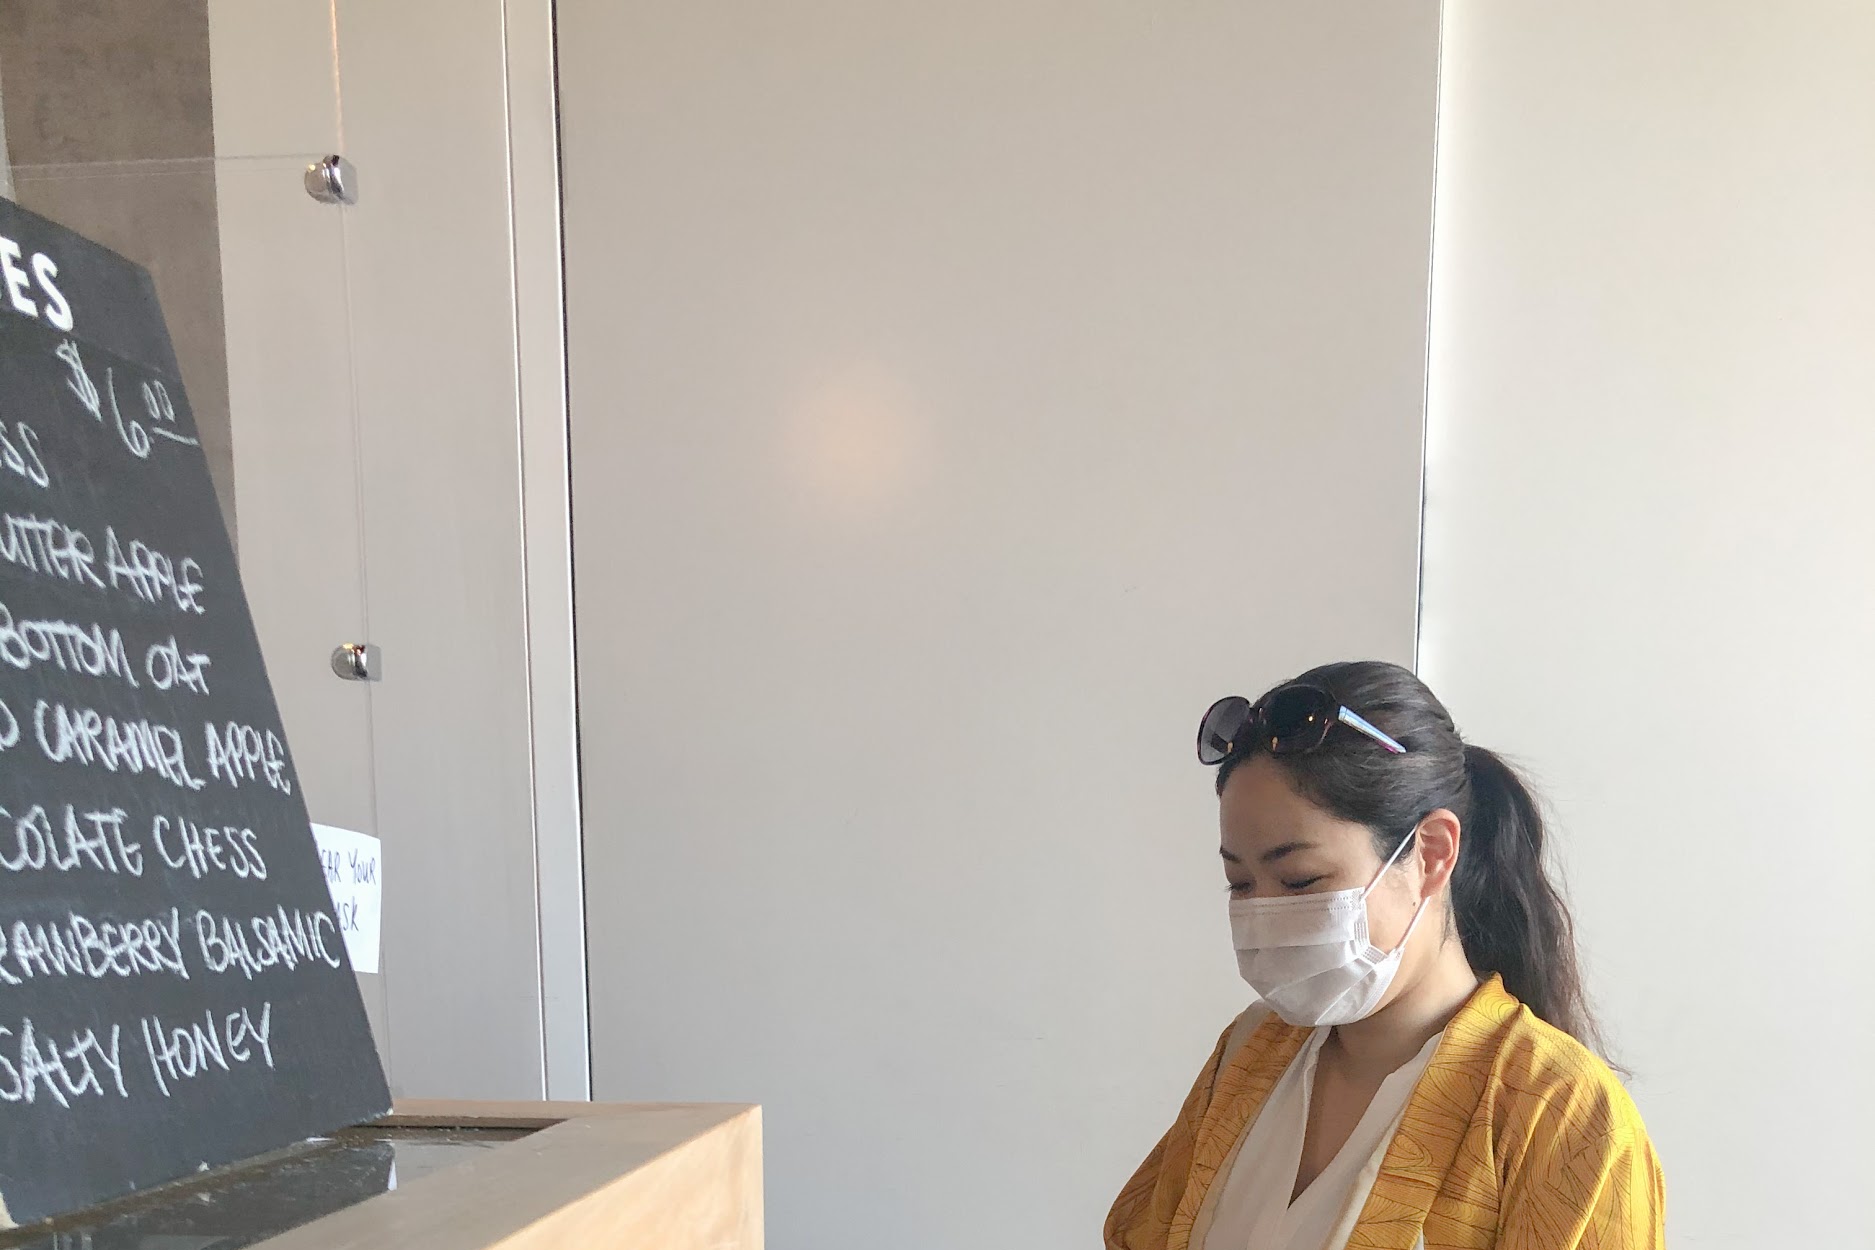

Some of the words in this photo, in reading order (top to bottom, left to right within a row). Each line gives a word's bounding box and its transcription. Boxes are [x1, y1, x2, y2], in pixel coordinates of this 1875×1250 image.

[105, 525, 206, 615] APPLE
[145, 634, 212, 696] OAT
[34, 699, 207, 791] CARAMEL
[204, 720, 292, 796] APPLE
[153, 814, 268, 881] CHESS
[195, 904, 341, 981] BALSAMIC
[0, 1016, 129, 1110] SALTY
[140, 1001, 276, 1098] HONEY
